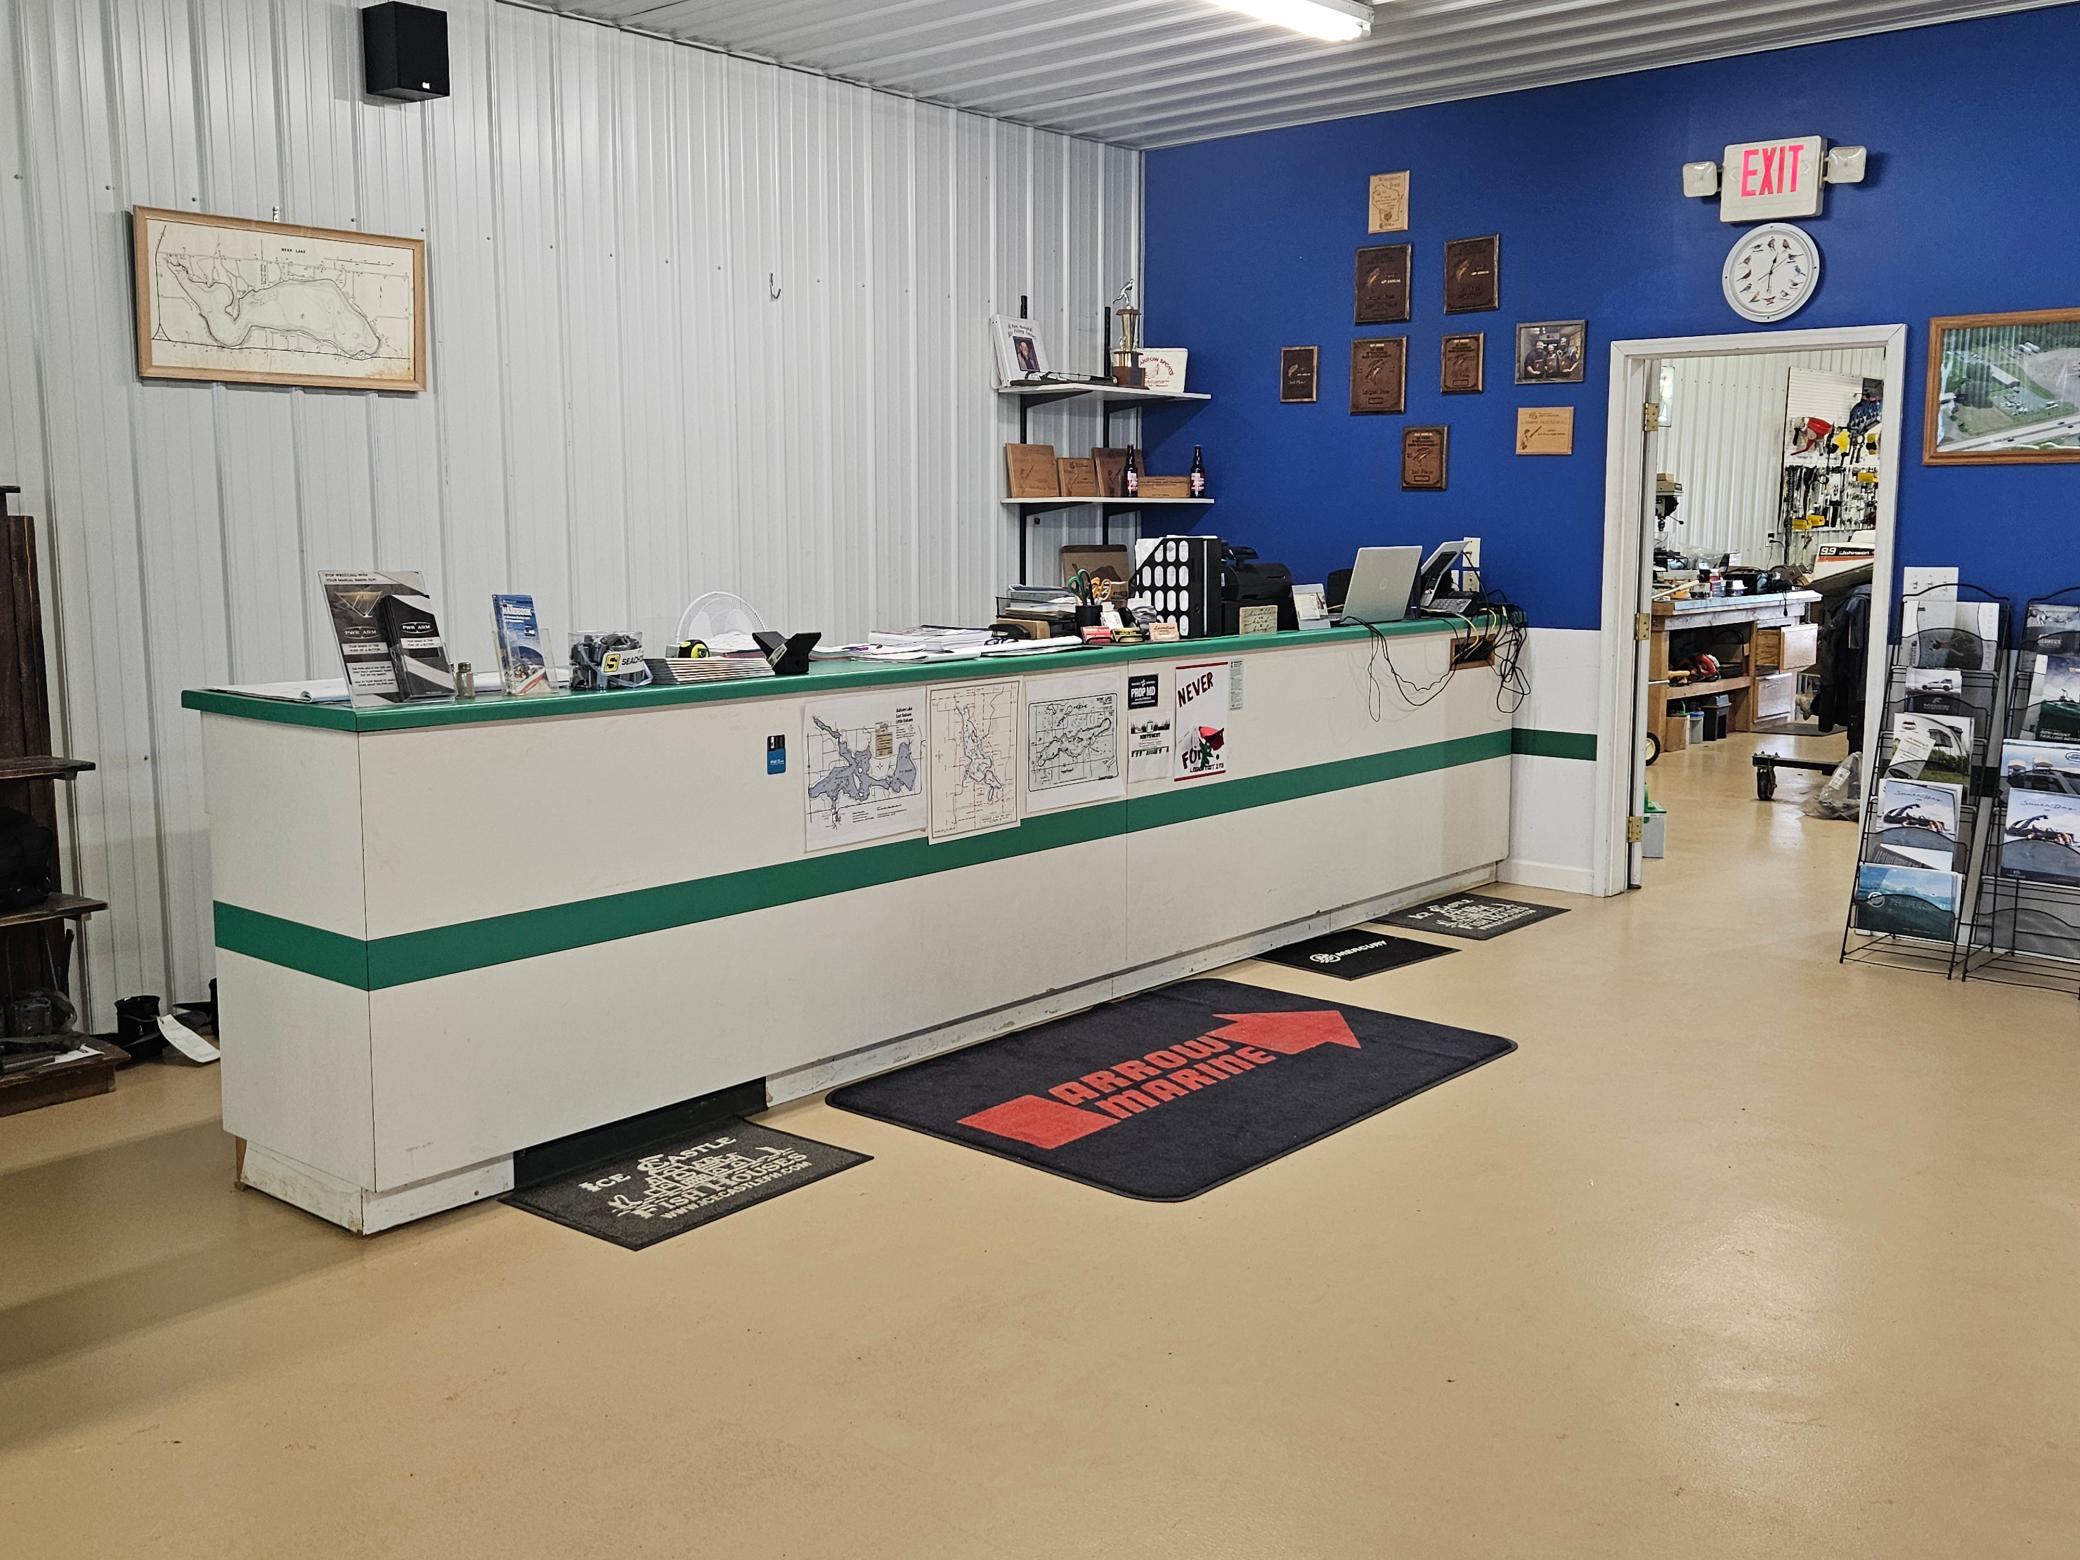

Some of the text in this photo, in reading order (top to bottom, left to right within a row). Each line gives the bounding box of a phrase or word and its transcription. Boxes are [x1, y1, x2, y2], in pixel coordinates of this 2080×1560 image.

[1740, 144, 1804, 197] EXIT
[1131, 686, 1156, 698] PROP MD
[1178, 672, 1213, 708] NEVER
[1335, 940, 1387, 957] MERCURY
[1048, 1032, 1233, 1106] ARROW
[1094, 1046, 1277, 1120] MARINE
[579, 1136, 737, 1192] ICE CASTLE
[632, 1152, 808, 1219] FISH HOUSES
